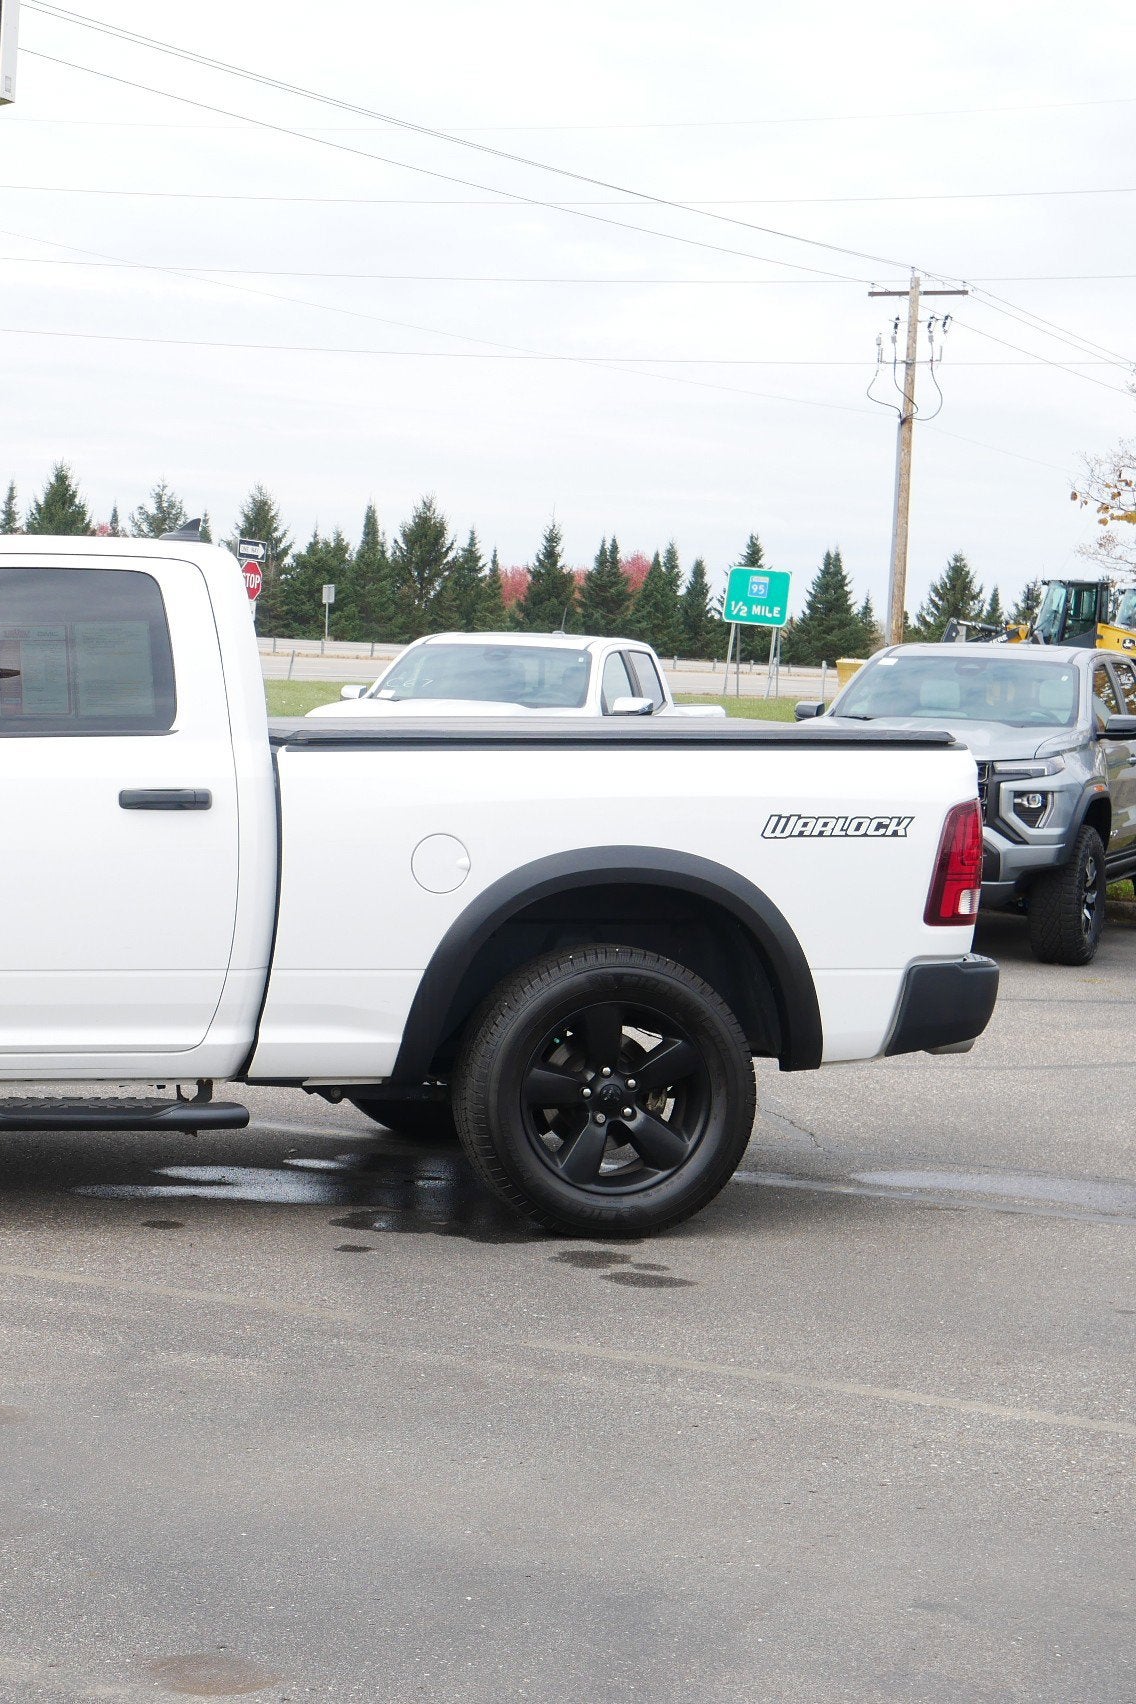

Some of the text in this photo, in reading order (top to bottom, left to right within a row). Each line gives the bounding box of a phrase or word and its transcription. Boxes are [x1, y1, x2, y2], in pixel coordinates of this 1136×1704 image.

[243, 573, 261, 589] TOP
[751, 584, 765, 595] 95
[751, 604, 781, 618] MILE
